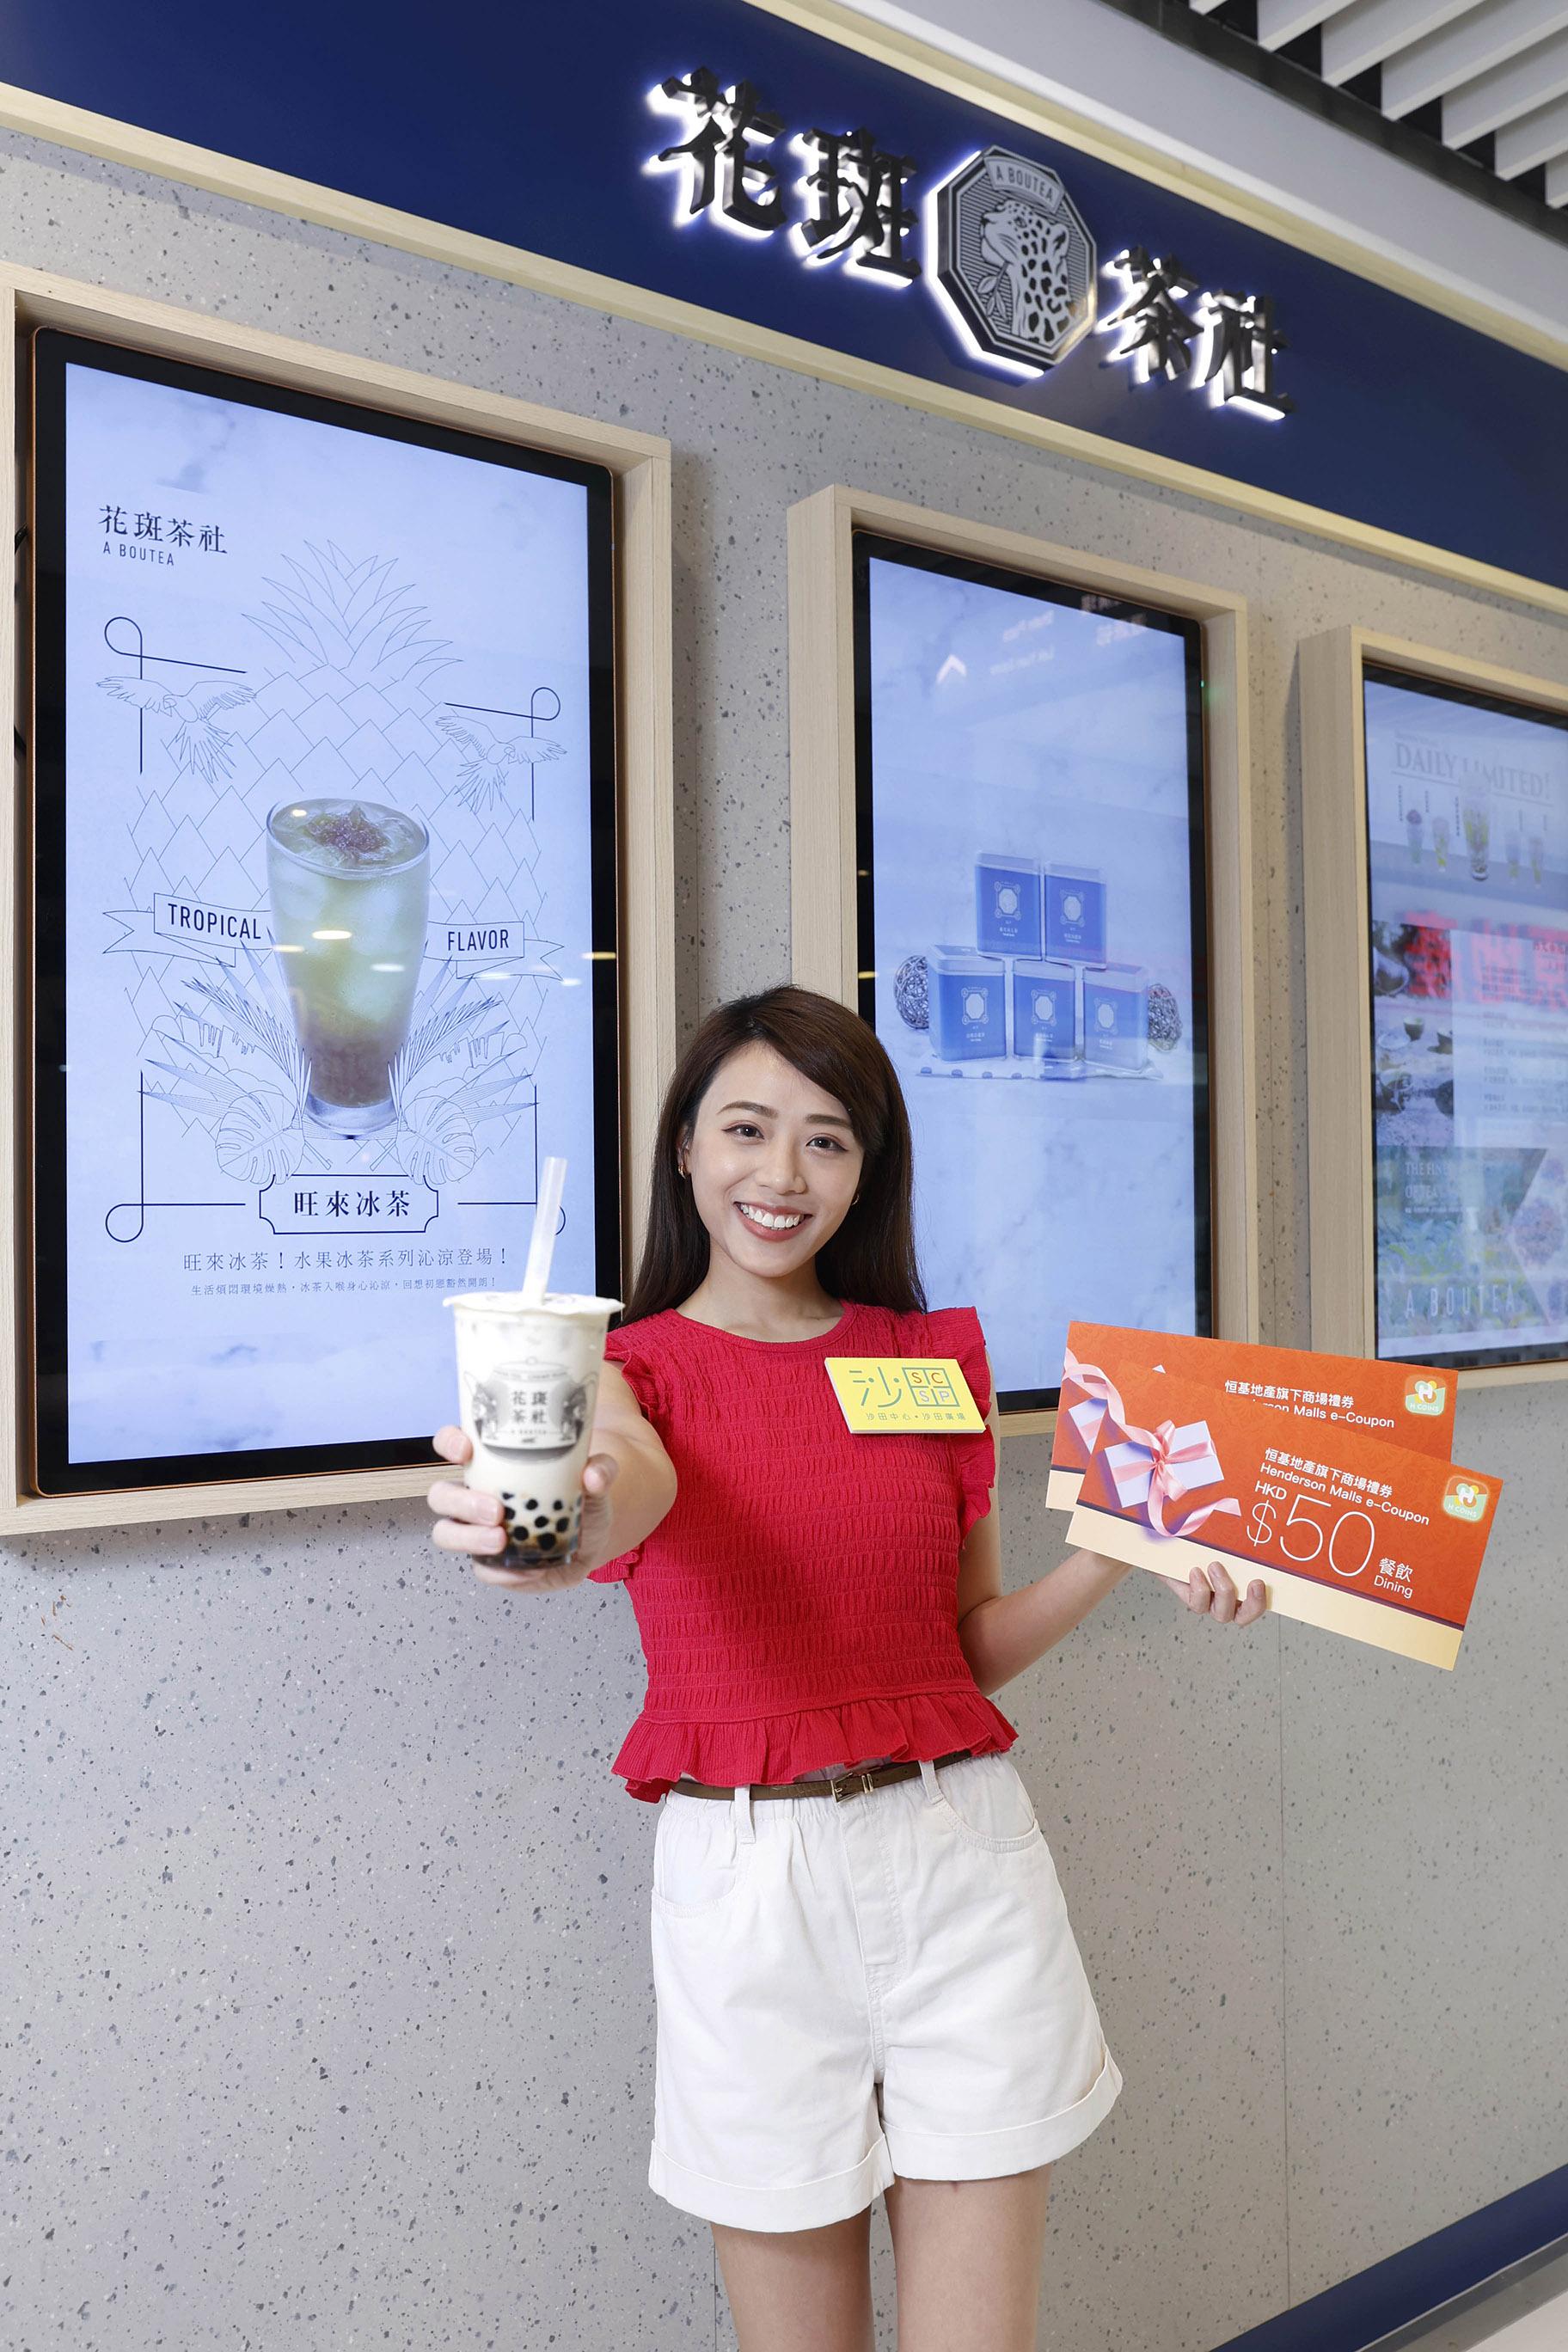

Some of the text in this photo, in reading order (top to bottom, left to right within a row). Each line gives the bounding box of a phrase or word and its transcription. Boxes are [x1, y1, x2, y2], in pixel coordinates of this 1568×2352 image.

[995, 164, 1054, 202] A BOUTEA
[97, 504, 228, 554] 花斑茶社
[102, 541, 175, 566] A BOUTEA
[1395, 741, 1458, 779] DAILY
[167, 903, 262, 940] TROPICAL
[447, 928, 510, 952] FLAVOR
[292, 1190, 411, 1219] 旺來冰茶
[1405, 1283, 1516, 1318] A BOUTEA
[1224, 1379, 1354, 1409] 恒基地產旗下商場禮券
[1293, 1403, 1326, 1419] Malls
[1330, 1411, 1395, 1429] e-Coupon
[1265, 1448, 1393, 1498] 恒基地產旗下商場禮券
[1254, 1480, 1288, 1501] HKD
[1259, 1461, 1430, 1526] Henderson Malls e-Coupon
[1246, 1493, 1375, 1577] $50
[1378, 1557, 1414, 1583] 餐飲
[1374, 1575, 1414, 1599] Dining
